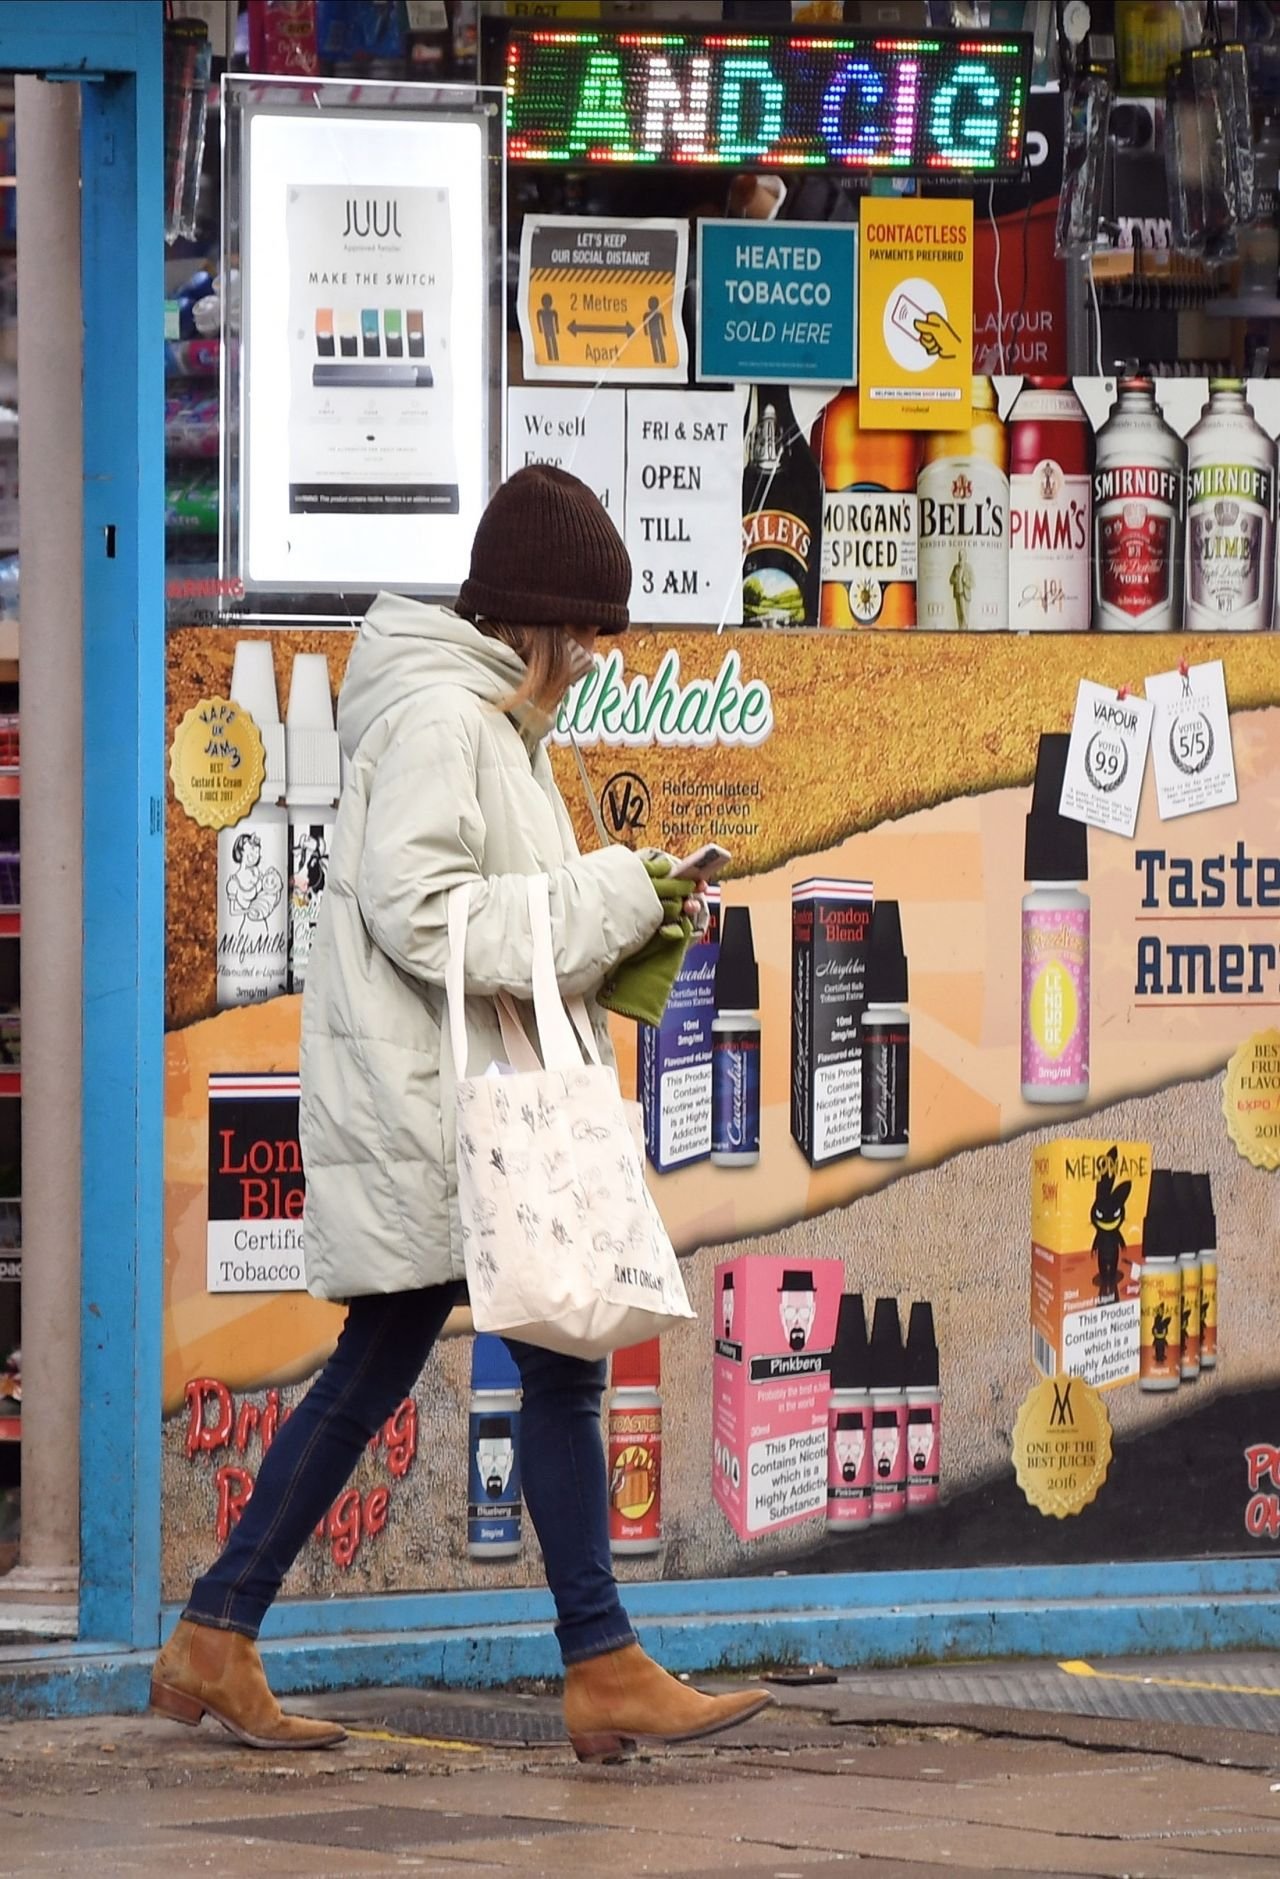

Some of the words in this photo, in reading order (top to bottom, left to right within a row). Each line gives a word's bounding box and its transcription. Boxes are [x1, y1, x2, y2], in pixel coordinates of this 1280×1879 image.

[569, 52, 783, 155] AND
[820, 61, 1000, 159] CIG
[343, 200, 401, 237] JUUL
[577, 232, 602, 248] LET'S
[604, 233, 627, 248] KEEP
[867, 223, 967, 244] CONTACTLESS
[551, 250, 570, 264] OUR
[572, 251, 603, 265] SOCIAL
[606, 251, 650, 266] DISTANCE
[736, 245, 821, 271] HEATED
[869, 248, 914, 261] PAYMENTS
[916, 249, 964, 262] PREFERRED
[309, 272, 348, 285] MAKE
[356, 273, 378, 285] THE
[386, 273, 436, 286] SWITCH
[570, 293, 578, 311] 2
[582, 294, 628, 313] Metres
[725, 280, 831, 307] TOBACCO
[724, 320, 776, 343] SOLD
[781, 322, 833, 345] HERE
[585, 344, 621, 364] Apart
[524, 415, 553, 437] We
[557, 416, 586, 437] sell
[642, 420, 669, 442] FRI
[674, 423, 687, 440] &
[692, 422, 729, 442] SAT
[642, 465, 702, 491] OPEN
[1095, 467, 1176, 502] SMIRNOFF
[919, 497, 1003, 538] BELL'S
[1010, 501, 1086, 550] PIMM'S
[640, 516, 691, 543] TILL
[832, 540, 897, 568] SPICED
[1204, 536, 1251, 561] LIME
[642, 570, 654, 594] 3
[662, 570, 699, 595] AM
[199, 705, 235, 724] VAPE
[1093, 700, 1139, 731] VAPOUR
[1178, 721, 1203, 733] VOTED
[1098, 741, 1121, 756] VOTED
[1179, 732, 1206, 759] 5/5
[210, 763, 224, 774] BEST
[1095, 751, 1119, 776] 9.9
[191, 777, 215, 789] Custard
[223, 777, 243, 789] Cream
[662, 781, 760, 797] Reformulated
[608, 782, 647, 832] V2
[671, 802, 691, 816] for
[695, 805, 713, 816] an
[716, 806, 751, 816] even
[661, 823, 705, 836] better
[710, 822, 760, 836] flavour
[1135, 841, 1280, 908] Taste
[820, 906, 869, 925] London
[826, 924, 865, 943] Blend
[666, 1076, 683, 1087] This
[820, 1071, 836, 1083] This
[673, 1085, 706, 1100] Contains
[826, 1081, 860, 1096] Contains
[662, 1102, 694, 1116] Nicotine
[816, 1096, 848, 1113] Nicotine
[686, 1108, 709, 1124] Highly
[672, 1124, 707, 1141] Addictive
[825, 1120, 860, 1137] Addictive
[218, 1129, 303, 1175] Lon
[669, 1136, 709, 1157] Substance
[219, 1260, 300, 1283] Tobacco
[1078, 1315, 1098, 1328] This
[1100, 1304, 1135, 1321] Product
[1065, 1326, 1107, 1347] Contains
[1084, 1340, 1112, 1357] which
[1114, 1336, 1121, 1346] is
[770, 1356, 822, 1375] Pinkberg
[1069, 1358, 1099, 1379] Highly
[766, 1442, 787, 1457] This
[789, 1432, 827, 1451] Product
[1026, 1441, 1051, 1454] ONE
[1055, 1441, 1071, 1454] OF
[1073, 1440, 1097, 1453] THE
[752, 1454, 797, 1477] Contains
[1027, 1456, 1056, 1469] BEST
[1058, 1455, 1097, 1471] JUICES
[771, 1469, 801, 1488] which
[803, 1466, 811, 1480] is
[1047, 1473, 1077, 1490] 2016
[755, 1489, 787, 1511] Highly
[769, 1495, 821, 1521] Substance
